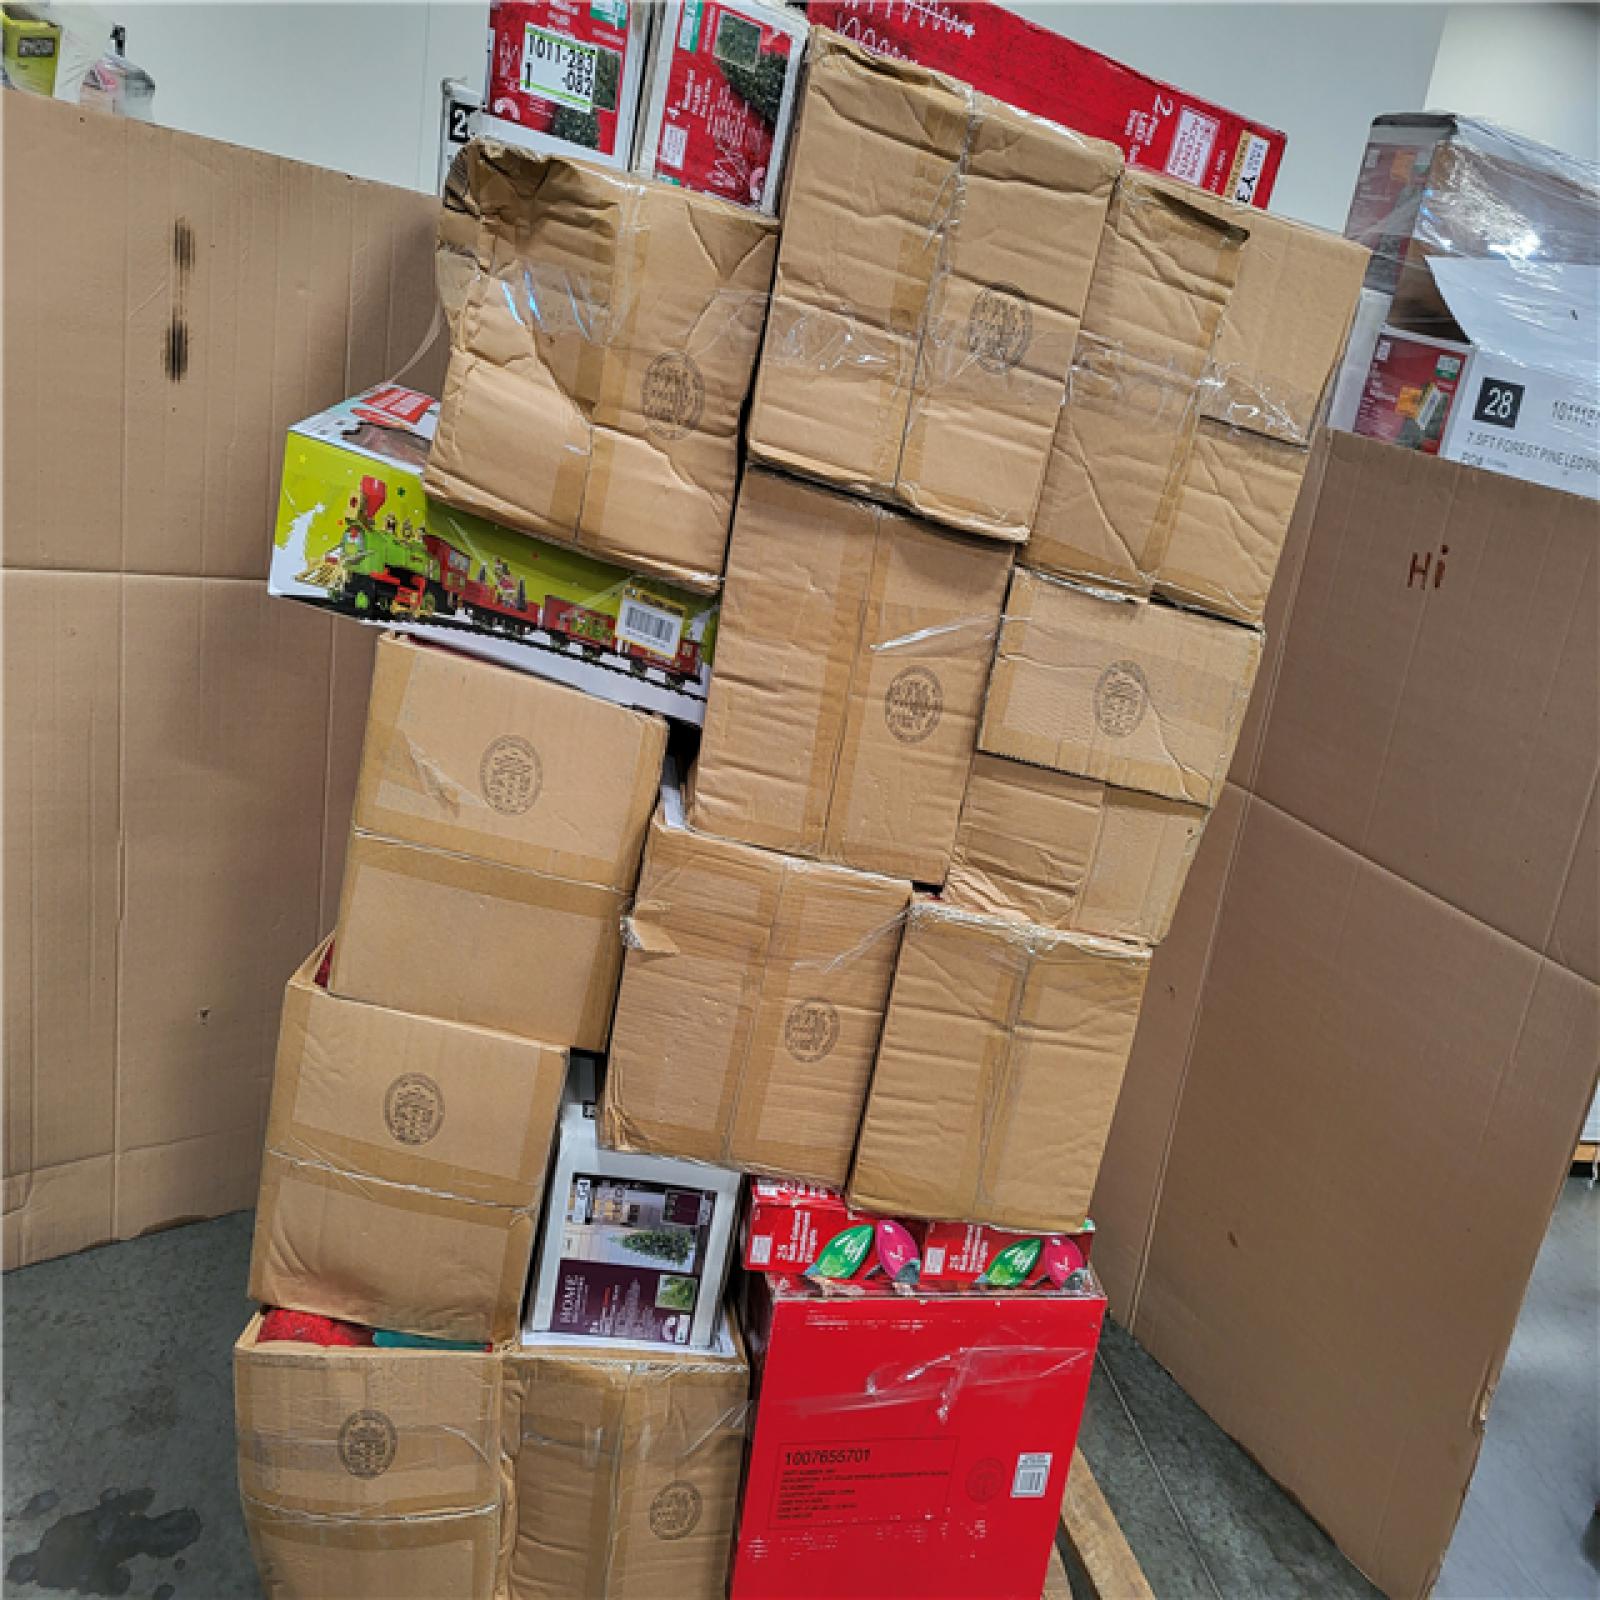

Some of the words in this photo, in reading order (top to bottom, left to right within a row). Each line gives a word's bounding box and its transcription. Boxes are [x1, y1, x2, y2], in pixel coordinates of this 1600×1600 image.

[1484, 386, 1513, 419] 28
[1407, 544, 1448, 591] Hi
[784, 1448, 872, 1466] 1007655701
